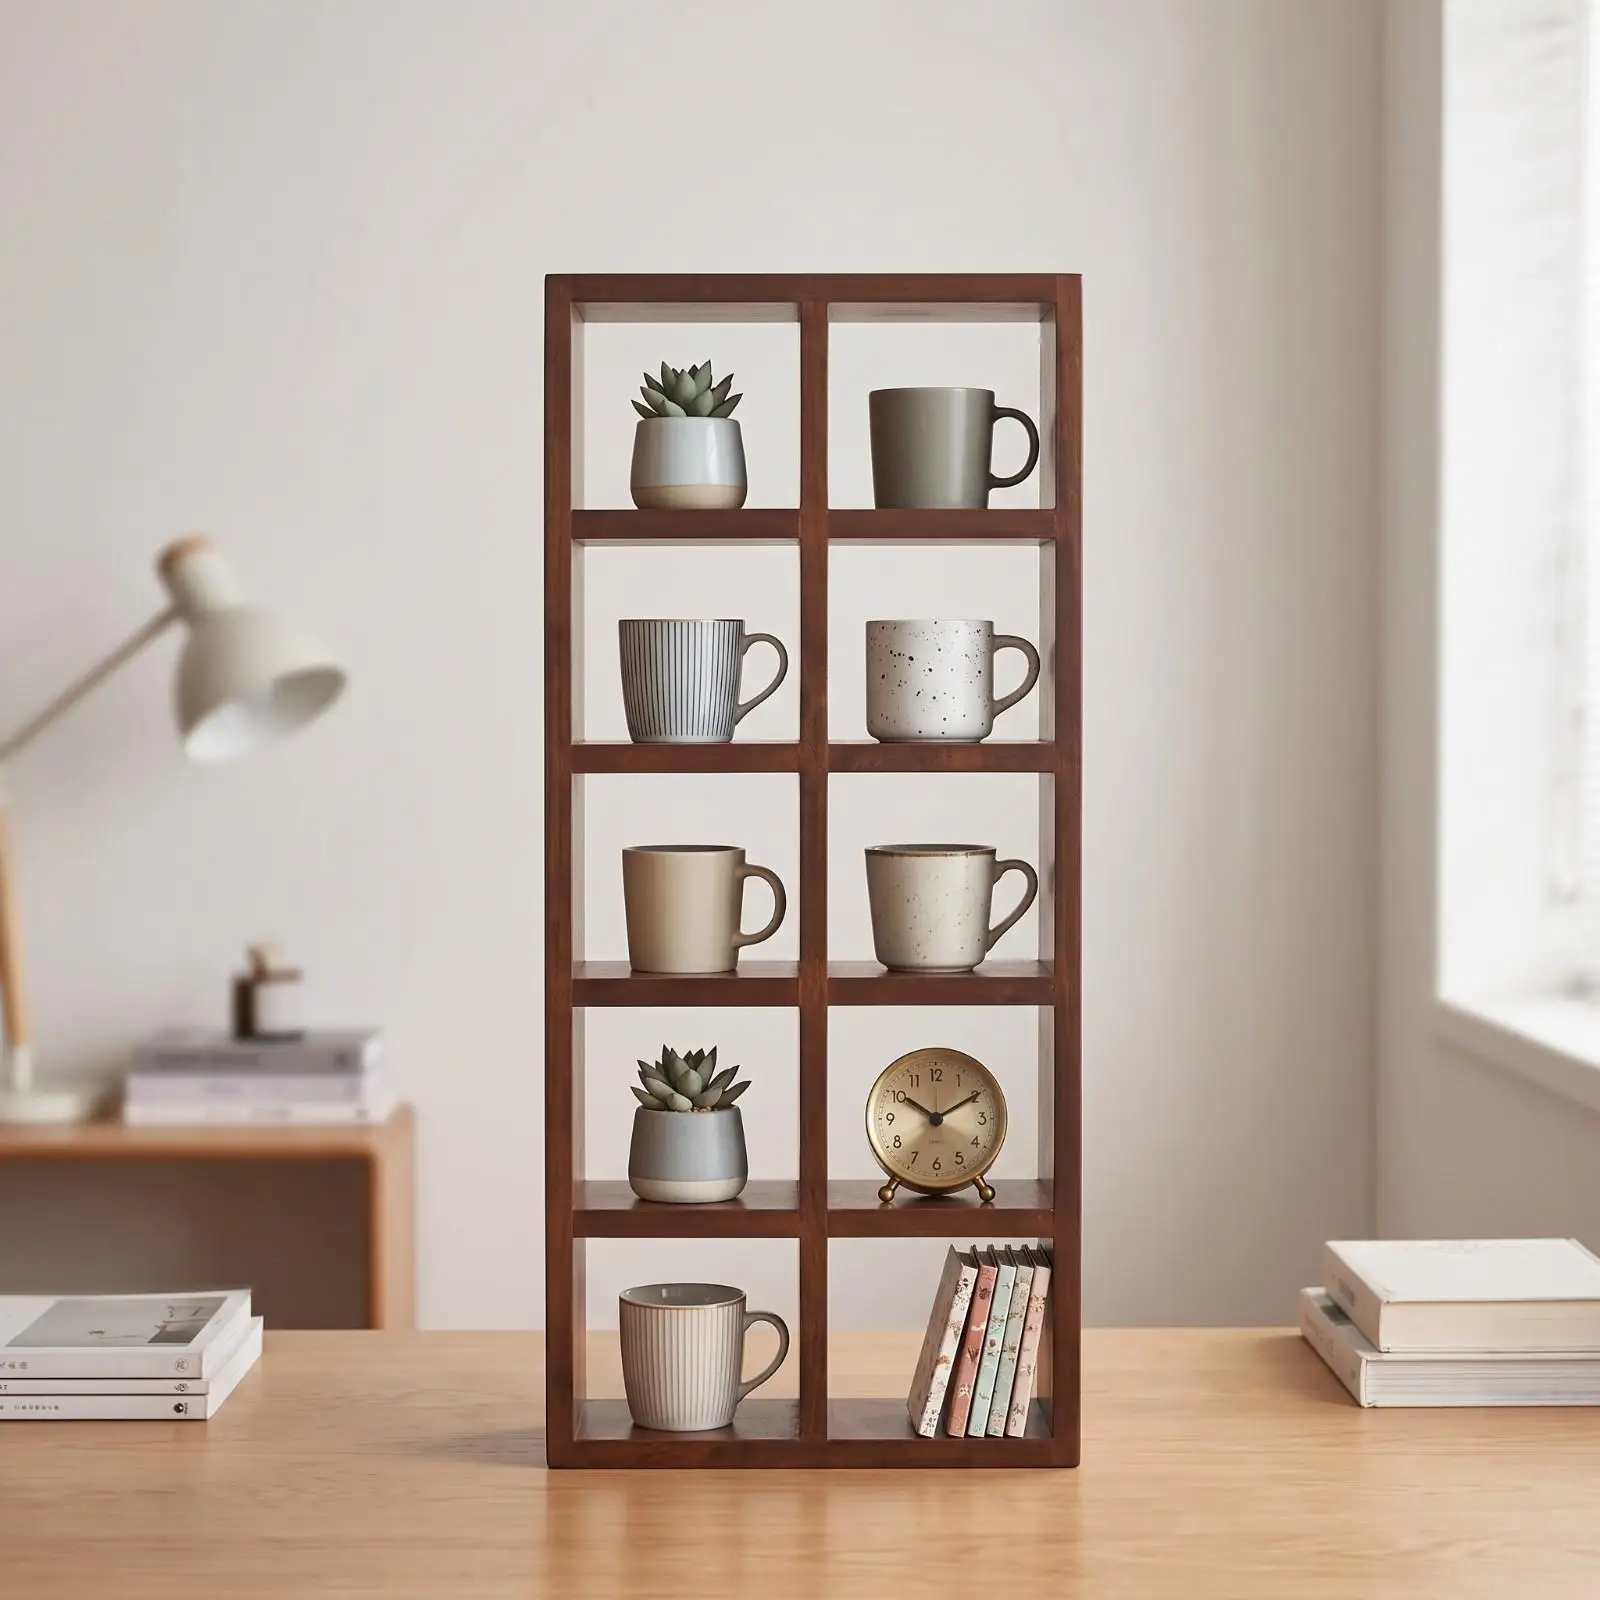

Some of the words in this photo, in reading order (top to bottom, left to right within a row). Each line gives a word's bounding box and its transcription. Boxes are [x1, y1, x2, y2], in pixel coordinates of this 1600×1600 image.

[909, 1075, 919, 1088] 11
[930, 1069, 942, 1082] 12
[956, 1074, 960, 1087] 1
[892, 1090, 907, 1104] 10
[971, 1090, 981, 1103] 2
[886, 1113, 894, 1126] 9
[977, 1112, 987, 1126] 3
[893, 1135, 902, 1149] 8
[971, 1136, 980, 1148] 4
[911, 1151, 919, 1165] 7
[932, 1157, 941, 1171] 6
[955, 1152, 964, 1165] 5
